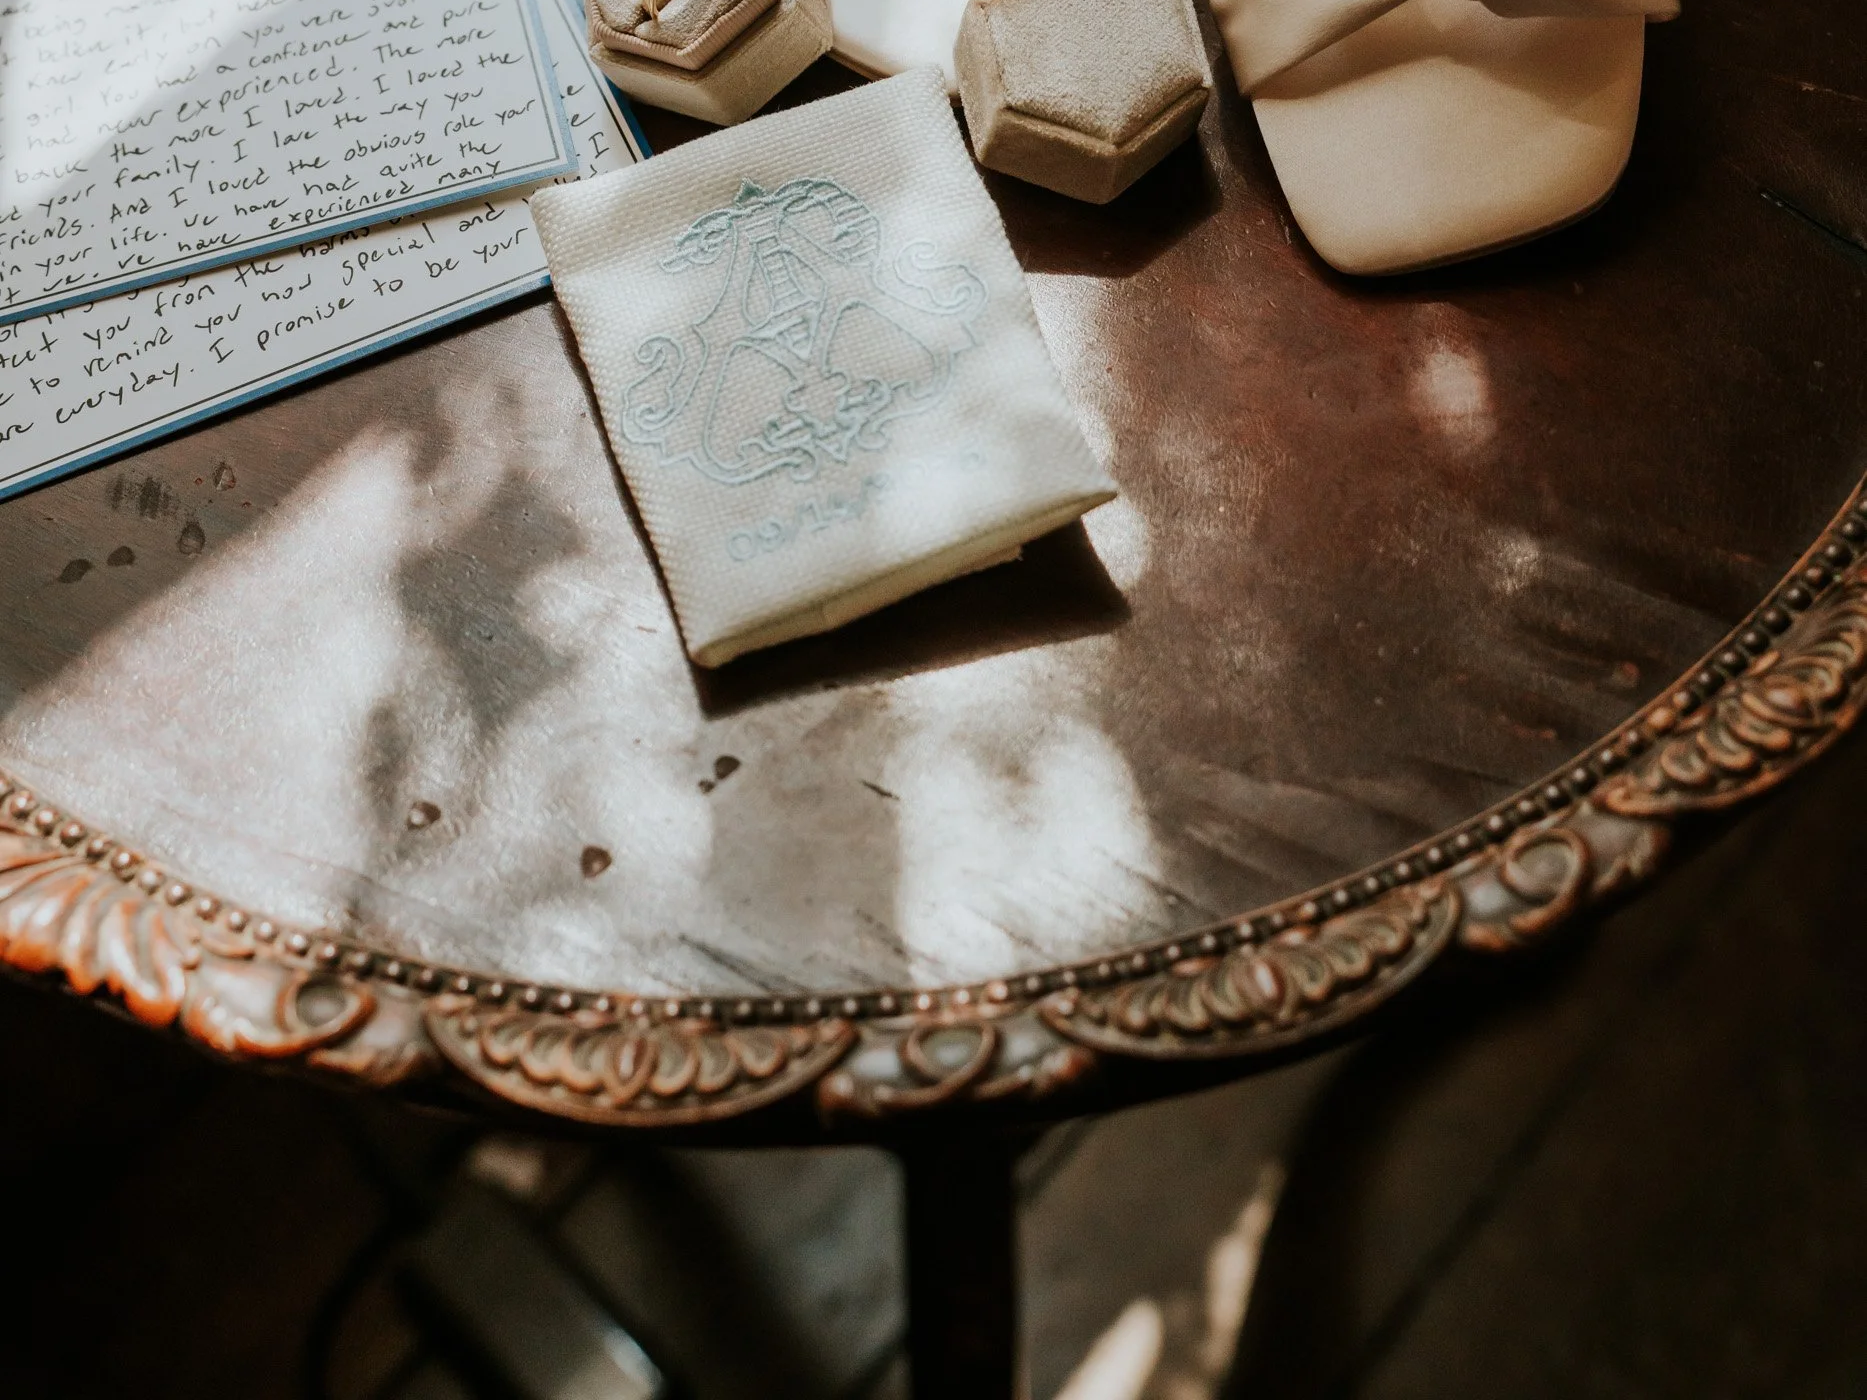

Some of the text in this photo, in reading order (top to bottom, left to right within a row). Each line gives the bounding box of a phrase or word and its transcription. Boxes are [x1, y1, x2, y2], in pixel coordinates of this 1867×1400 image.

[27, 124, 77, 151] had
[98, 109, 163, 134] never
[372, 44, 424, 63] The
[437, 29, 497, 49] more
[155, 64, 200, 88] had
[216, 65, 236, 75] a
[249, 30, 371, 68] confidence
[383, 15, 424, 33] and
[442, 1, 500, 28] pure
[187, 36, 221, 54] on
[242, 24, 284, 48] you
[301, 9, 353, 27] were
[15, 159, 88, 183] back
[110, 143, 154, 163] the
[168, 123, 226, 147] more
[243, 105, 263, 128] I
[373, 73, 391, 94] I
[408, 60, 464, 86] loved
[478, 51, 525, 69] the
[39, 184, 96, 217] your
[232, 139, 248, 163] I
[273, 130, 319, 148] love
[334, 113, 368, 129] the
[380, 98, 428, 119] way
[444, 87, 483, 111] you
[110, 198, 152, 223] And
[169, 187, 188, 208] I
[209, 167, 271, 194] loved
[288, 155, 331, 175] the
[344, 131, 426, 161] obvious
[444, 114, 485, 136] role
[495, 100, 535, 126] your
[35, 247, 92, 277] your
[235, 197, 290, 217] have
[303, 176, 360, 196] had
[380, 153, 443, 178] quite
[459, 140, 502, 157] the
[178, 232, 242, 252] have
[268, 181, 415, 230] experienced
[438, 160, 501, 184] many
[30, 201, 505, 395] to remind you how special and
[83, 316, 131, 350] you
[155, 284, 215, 317] from
[234, 261, 284, 287] the
[209, 337, 234, 364] I
[257, 297, 355, 351] promise
[372, 278, 404, 297] to
[424, 258, 460, 278] be
[472, 227, 529, 264] your
